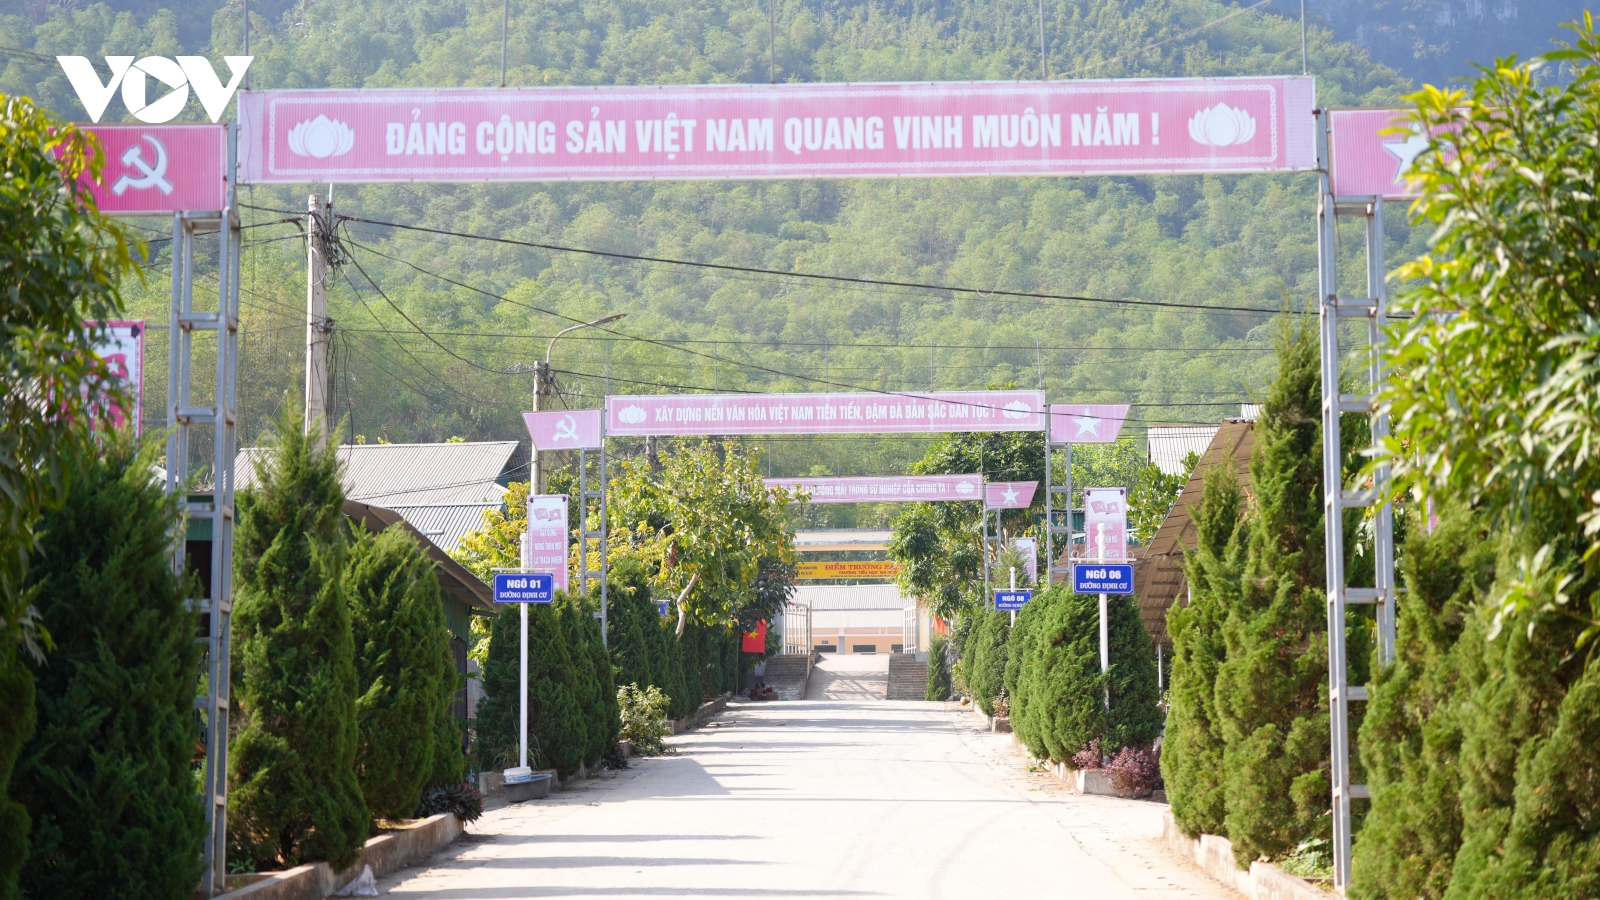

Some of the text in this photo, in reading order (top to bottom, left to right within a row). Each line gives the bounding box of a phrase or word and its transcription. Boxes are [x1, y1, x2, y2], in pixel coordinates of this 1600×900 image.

[386, 108, 466, 155] ĐẢNG
[476, 114, 556, 161] CỘNG
[565, 106, 626, 153] SẢN
[635, 112, 697, 160] VIỆT
[706, 118, 774, 152] NAM
[784, 116, 884, 154] QUANG
[893, 115, 963, 149] VINH
[972, 107, 1061, 148] MUÔN
[1071, 106, 1140, 146] NĂM
[655, 404, 674, 422] XÂY
[676, 406, 702, 425] DỰNG
[704, 402, 724, 422] NỀN
[726, 404, 745, 421] VĂN
[748, 403, 767, 421] HÓA
[769, 403, 789, 424] VIỆT
[791, 405, 814, 420] NAM
[816, 402, 837, 420] TIÊN
[865, 402, 887, 423] ĐẬM
[889, 402, 903, 419] ĐÀ
[905, 399, 925, 419] BẢN
[848, 484, 868, 495] TRONG
[1086, 568, 1121, 579] NGÕ 06
[507, 578, 527, 589] NGÕ
[530, 579, 541, 589] 01
